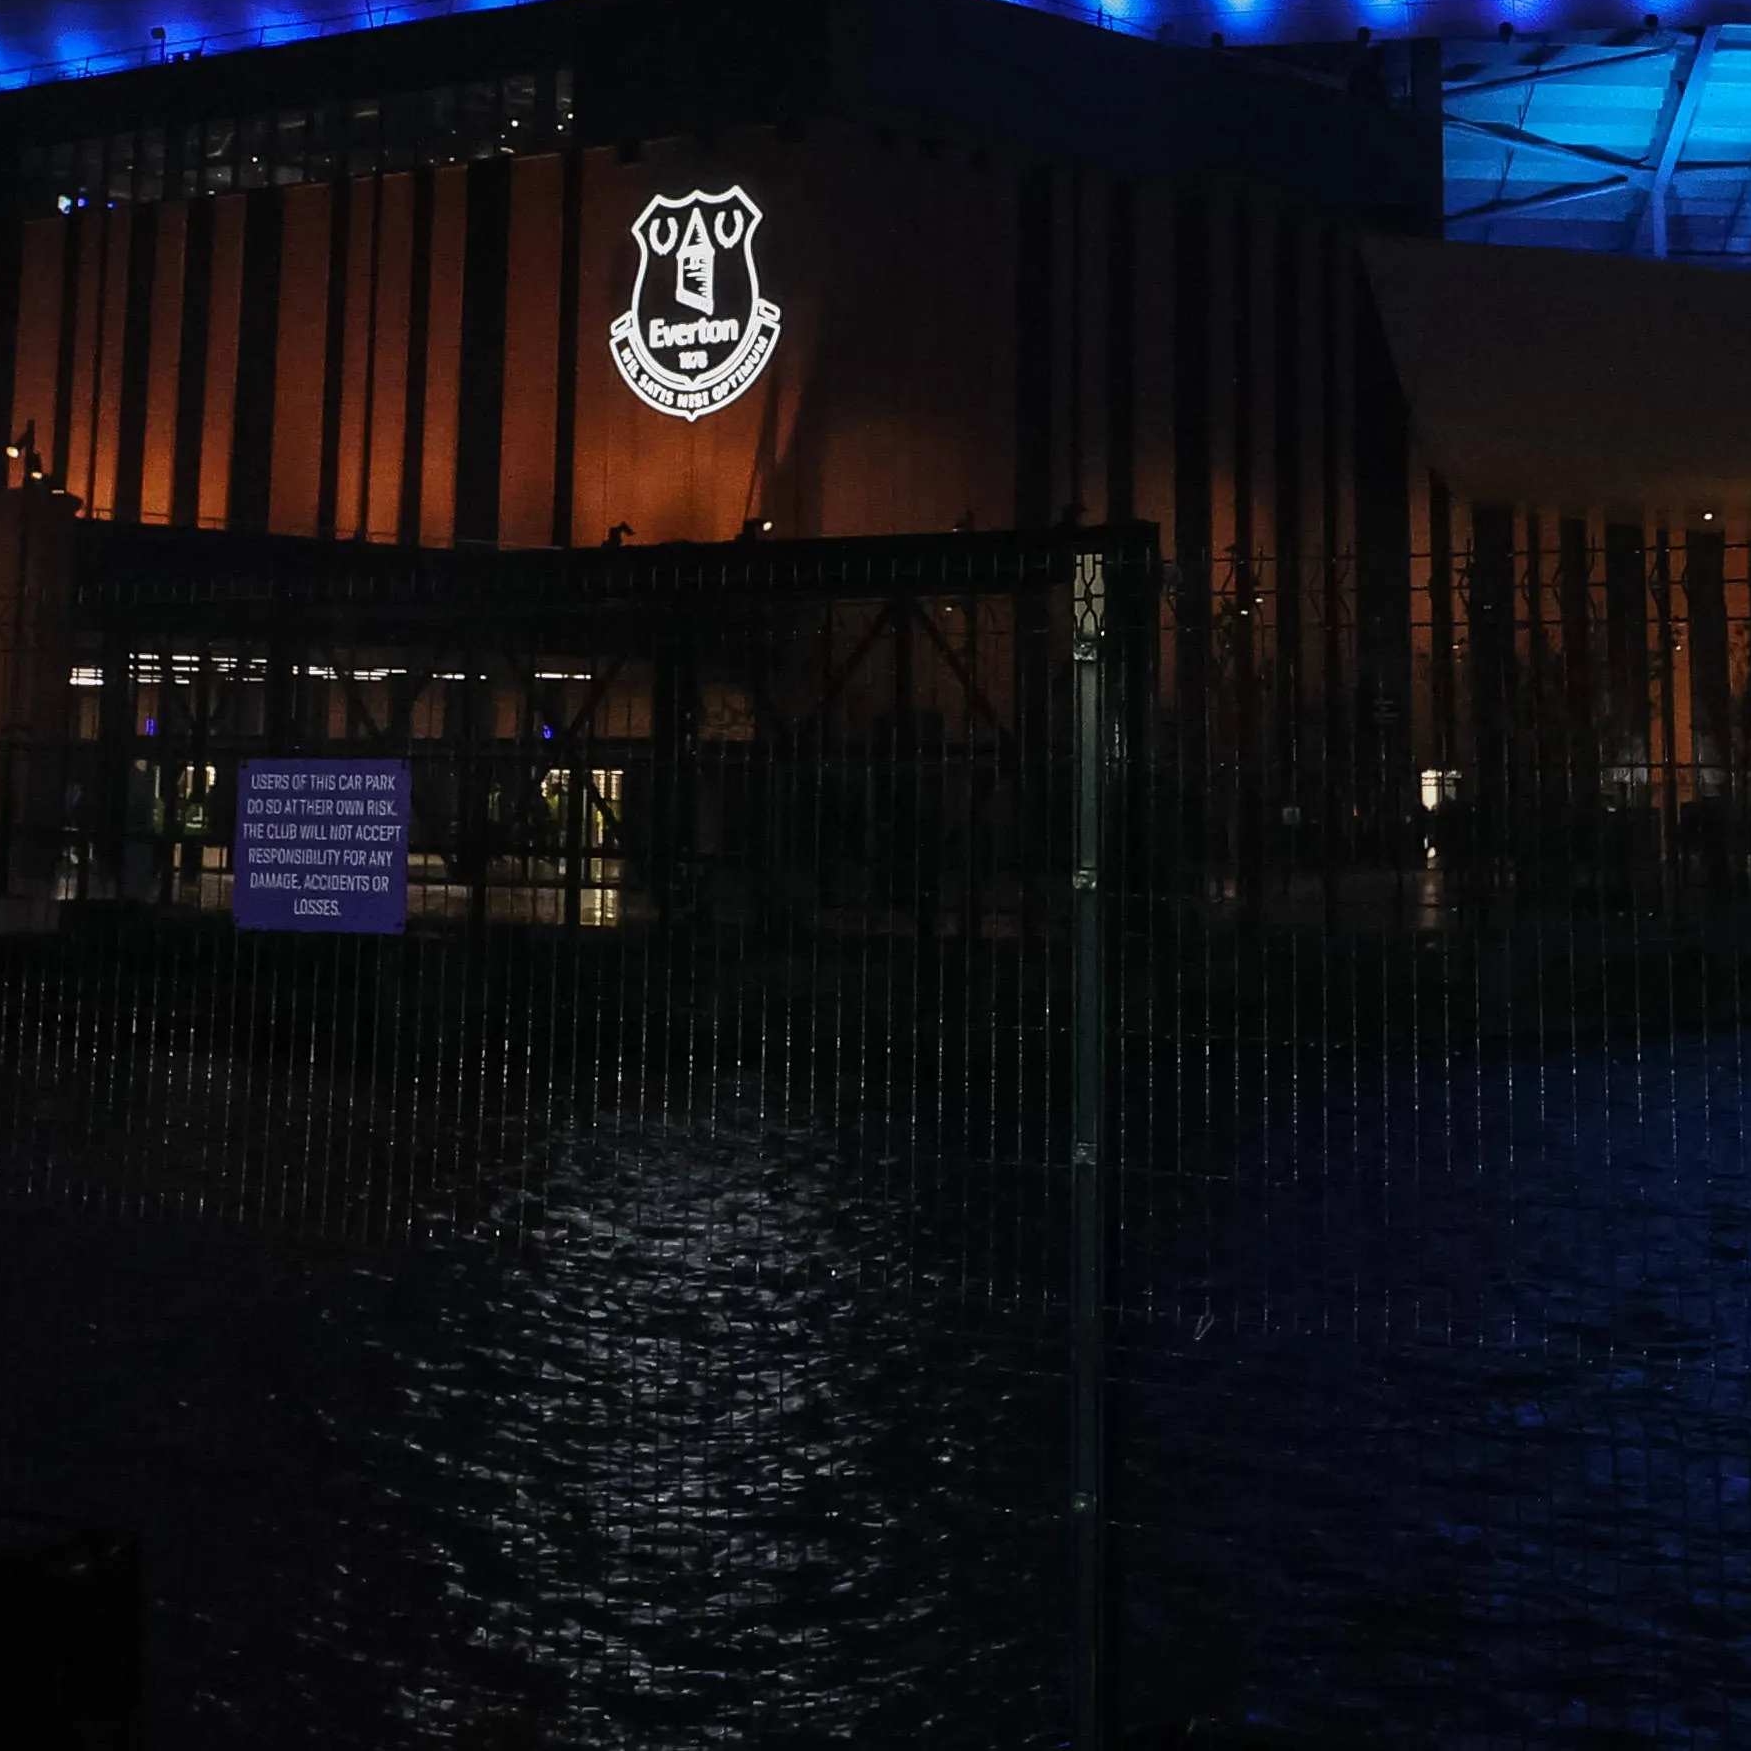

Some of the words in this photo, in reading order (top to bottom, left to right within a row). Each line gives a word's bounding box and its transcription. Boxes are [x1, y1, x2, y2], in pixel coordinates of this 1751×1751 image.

[649, 317, 739, 348] Everton
[620, 347, 638, 380] NIL
[637, 375, 674, 406] SATIS
[676, 391, 710, 409] NISI
[711, 334, 769, 401] OPTIMUM
[251, 774, 289, 790] USERS
[292, 774, 307, 790] OF
[310, 774, 336, 791] THIS
[338, 774, 362, 791] CAR
[365, 774, 395, 791] PARK
[247, 798, 263, 815] DO
[266, 799, 281, 815] SO
[283, 799, 298, 815] AT
[299, 799, 334, 816] THEIR
[336, 800, 364, 816] OWN
[367, 800, 398, 817] RISK.
[242, 822, 264, 840] THE
[266, 823, 297, 840] CLUB
[299, 824, 328, 841] WILL
[330, 824, 354, 841] NOT
[355, 825, 402, 842] ACCEPT
[248, 847, 341, 866] RESPONSIBILITY
[343, 849, 367, 867] FOR
[369, 850, 394, 867] ANY
[250, 872, 302, 890] DAMAGE,
[303, 873, 370, 892] ACCIDENTS
[372, 875, 390, 892] OR
[293, 898, 342, 916] LOSSES.
